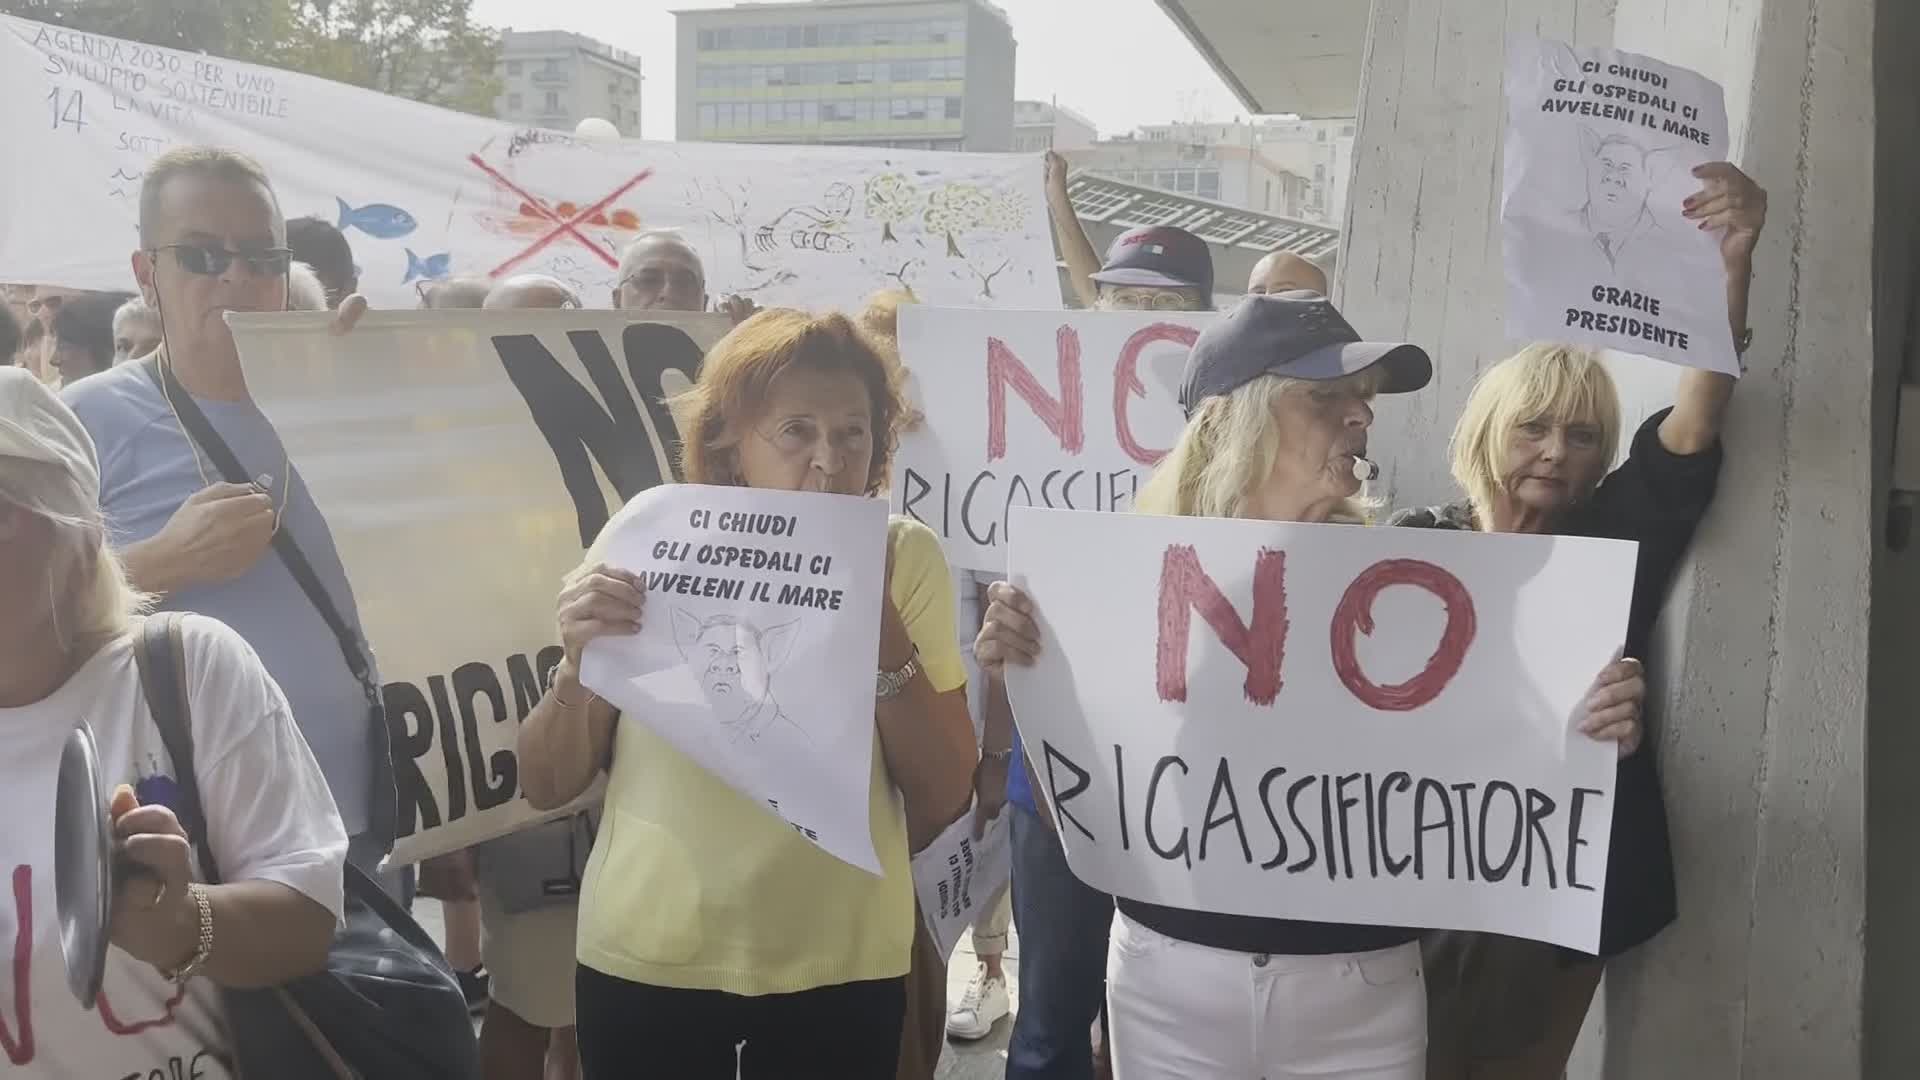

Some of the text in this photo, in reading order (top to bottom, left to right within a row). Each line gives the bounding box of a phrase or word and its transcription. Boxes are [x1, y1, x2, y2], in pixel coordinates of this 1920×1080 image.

[33, 26, 275, 94] AGENDA 2030 PER UNO
[1582, 61, 1668, 89] CI CHIUDI
[45, 54, 288, 119] SVILUPPO SOSTENIBILE
[113, 95, 140, 112] LA
[1553, 78, 1699, 121] GLI OSPEDALI CI
[47, 86, 88, 134] 14
[1541, 98, 1710, 145] AVVELENI IL MARE
[1591, 284, 1661, 316] GRAZIE
[1566, 308, 1689, 350] PRESIDENTE
[690, 509, 798, 537] CI CHIUDI
[652, 540, 832, 576] GLI OSPEDALI CI
[750, 581, 770, 603] IL
[777, 584, 843, 611] MARE
[1156, 544, 1477, 712] NO
[1042, 739, 1604, 892] RIGASSIFICATORE
